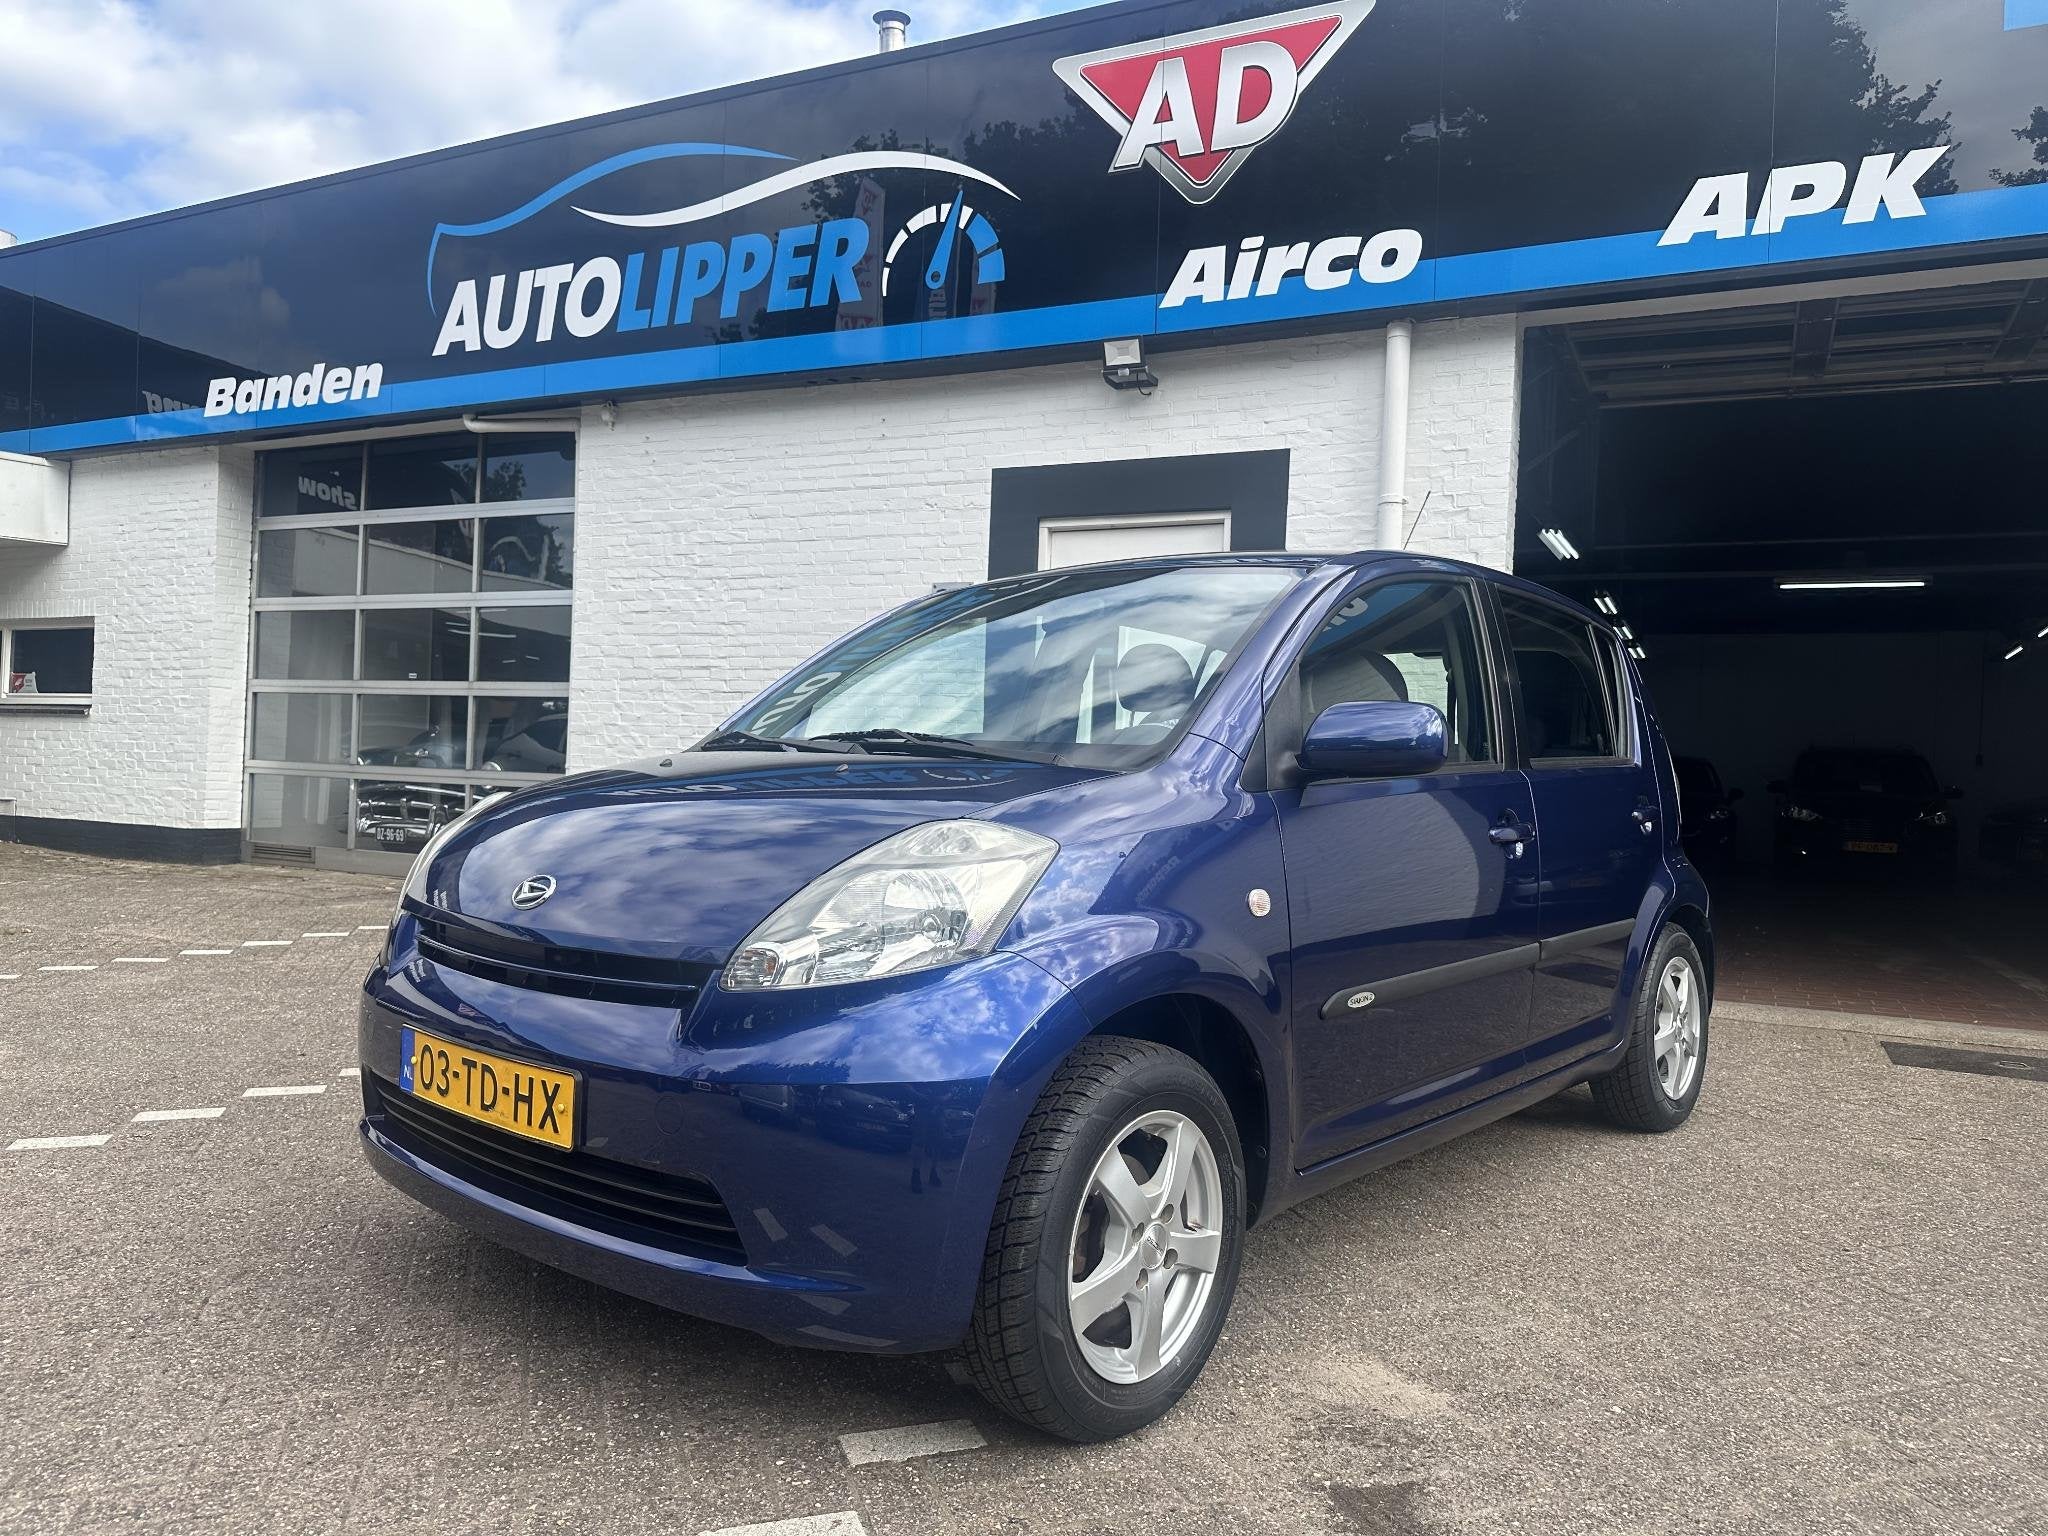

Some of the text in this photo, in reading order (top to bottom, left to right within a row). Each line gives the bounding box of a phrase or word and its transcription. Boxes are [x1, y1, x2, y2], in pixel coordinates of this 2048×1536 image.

[1114, 40, 1299, 168] AD
[1657, 144, 1951, 247] APK
[431, 217, 870, 357] AUTOLIPPER
[1159, 228, 1423, 309] Airco
[203, 362, 383, 418] Banden
[403, 1065, 413, 1081] NL
[420, 1043, 561, 1134] 03-TD-HX
